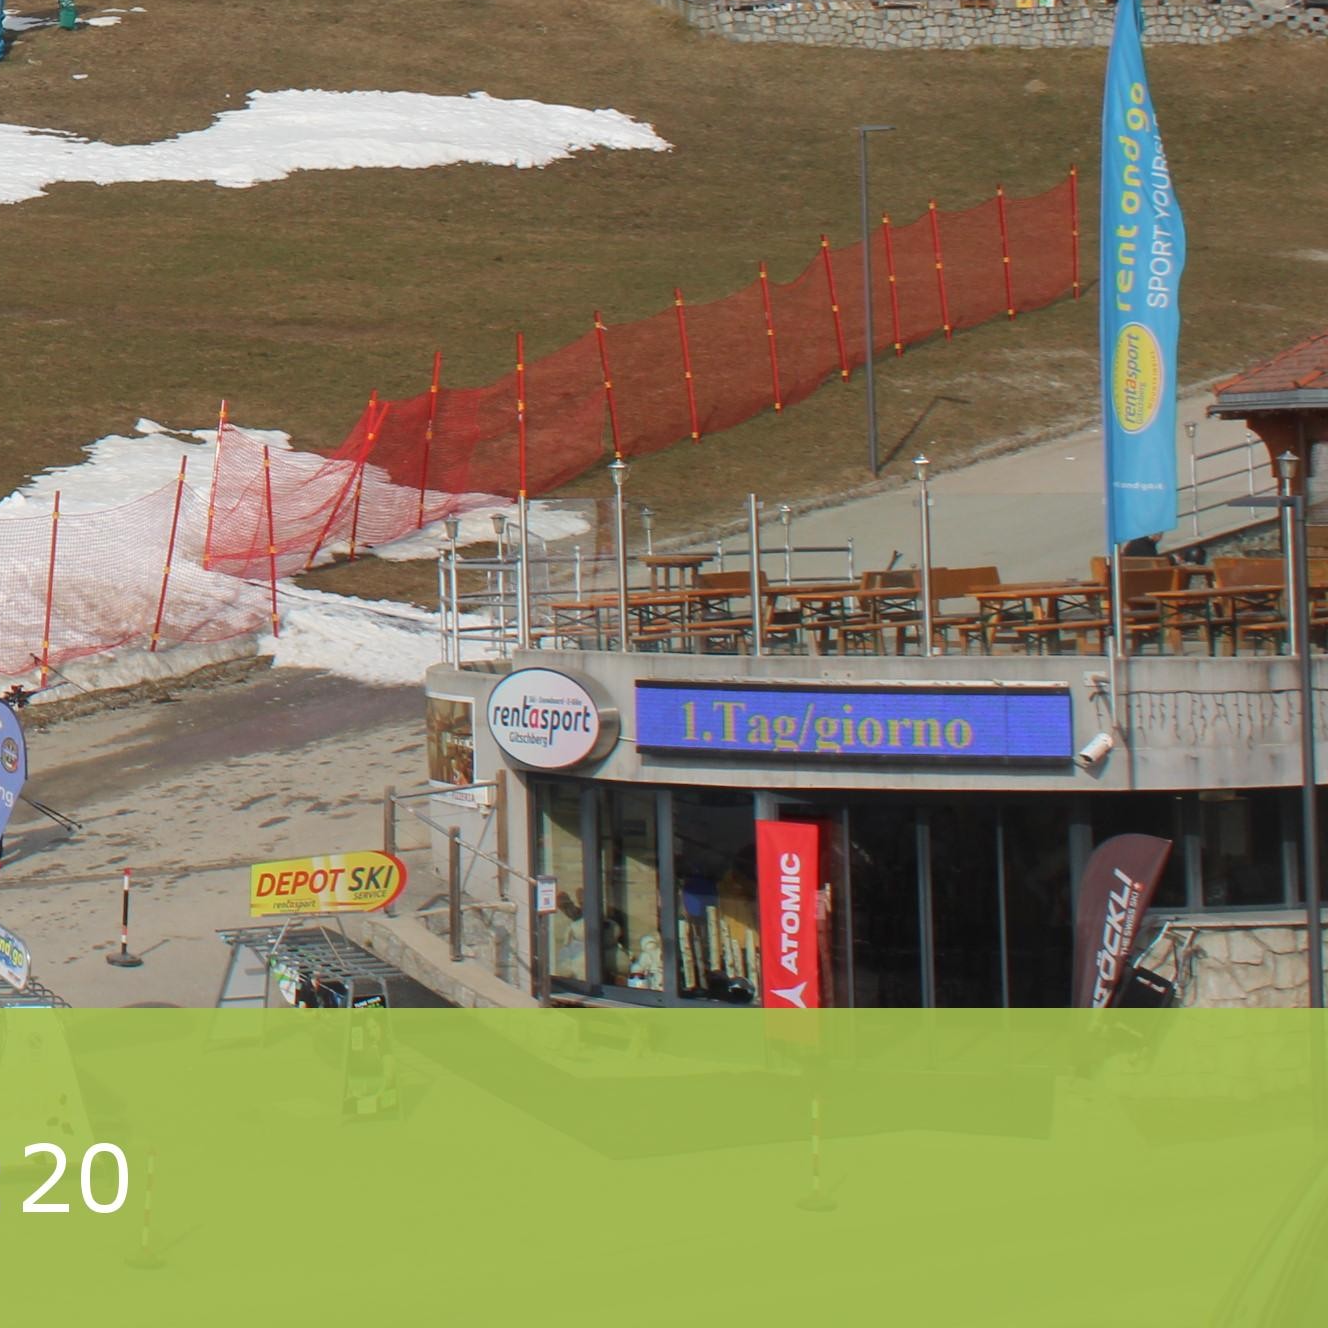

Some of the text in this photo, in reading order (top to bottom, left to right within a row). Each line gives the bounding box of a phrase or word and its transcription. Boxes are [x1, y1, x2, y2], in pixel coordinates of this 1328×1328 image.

[1126, 82, 1150, 133] go
[1115, 224, 1139, 313] rent
[1147, 224, 1172, 309] SPORT
[1125, 332, 1141, 424] rentasport
[493, 694, 591, 746] rentasport
[508, 731, 548, 748] Gitschberg
[256, 865, 394, 897] DEPOT SKI
[353, 889, 387, 901] SERVICE
[780, 852, 801, 976] ATOMIC
[11, 948, 24, 968] go
